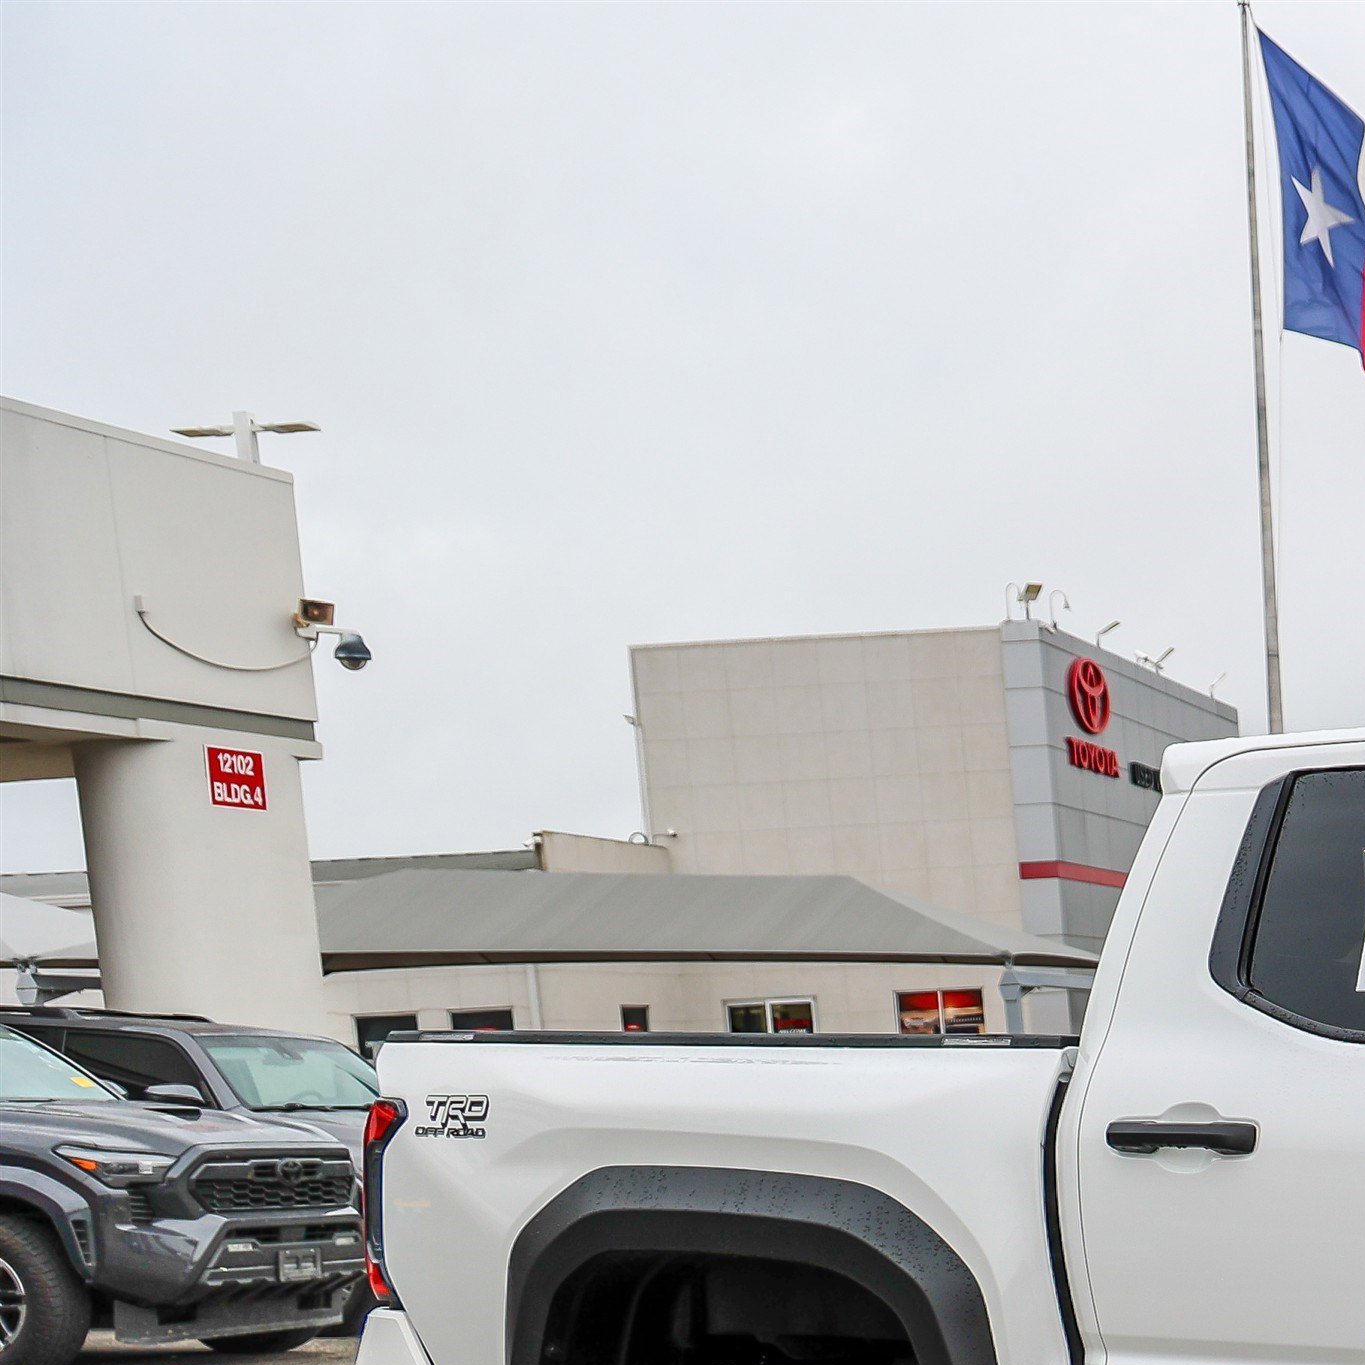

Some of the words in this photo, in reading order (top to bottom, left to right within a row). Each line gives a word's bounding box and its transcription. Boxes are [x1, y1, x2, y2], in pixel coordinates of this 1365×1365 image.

[217, 752, 255, 776] 12102
[1065, 736, 1120, 779] TOYOTA
[425, 1094, 490, 1129] TRD
[415, 1126, 445, 1137] OFF
[446, 1127, 487, 1139] ROAD
